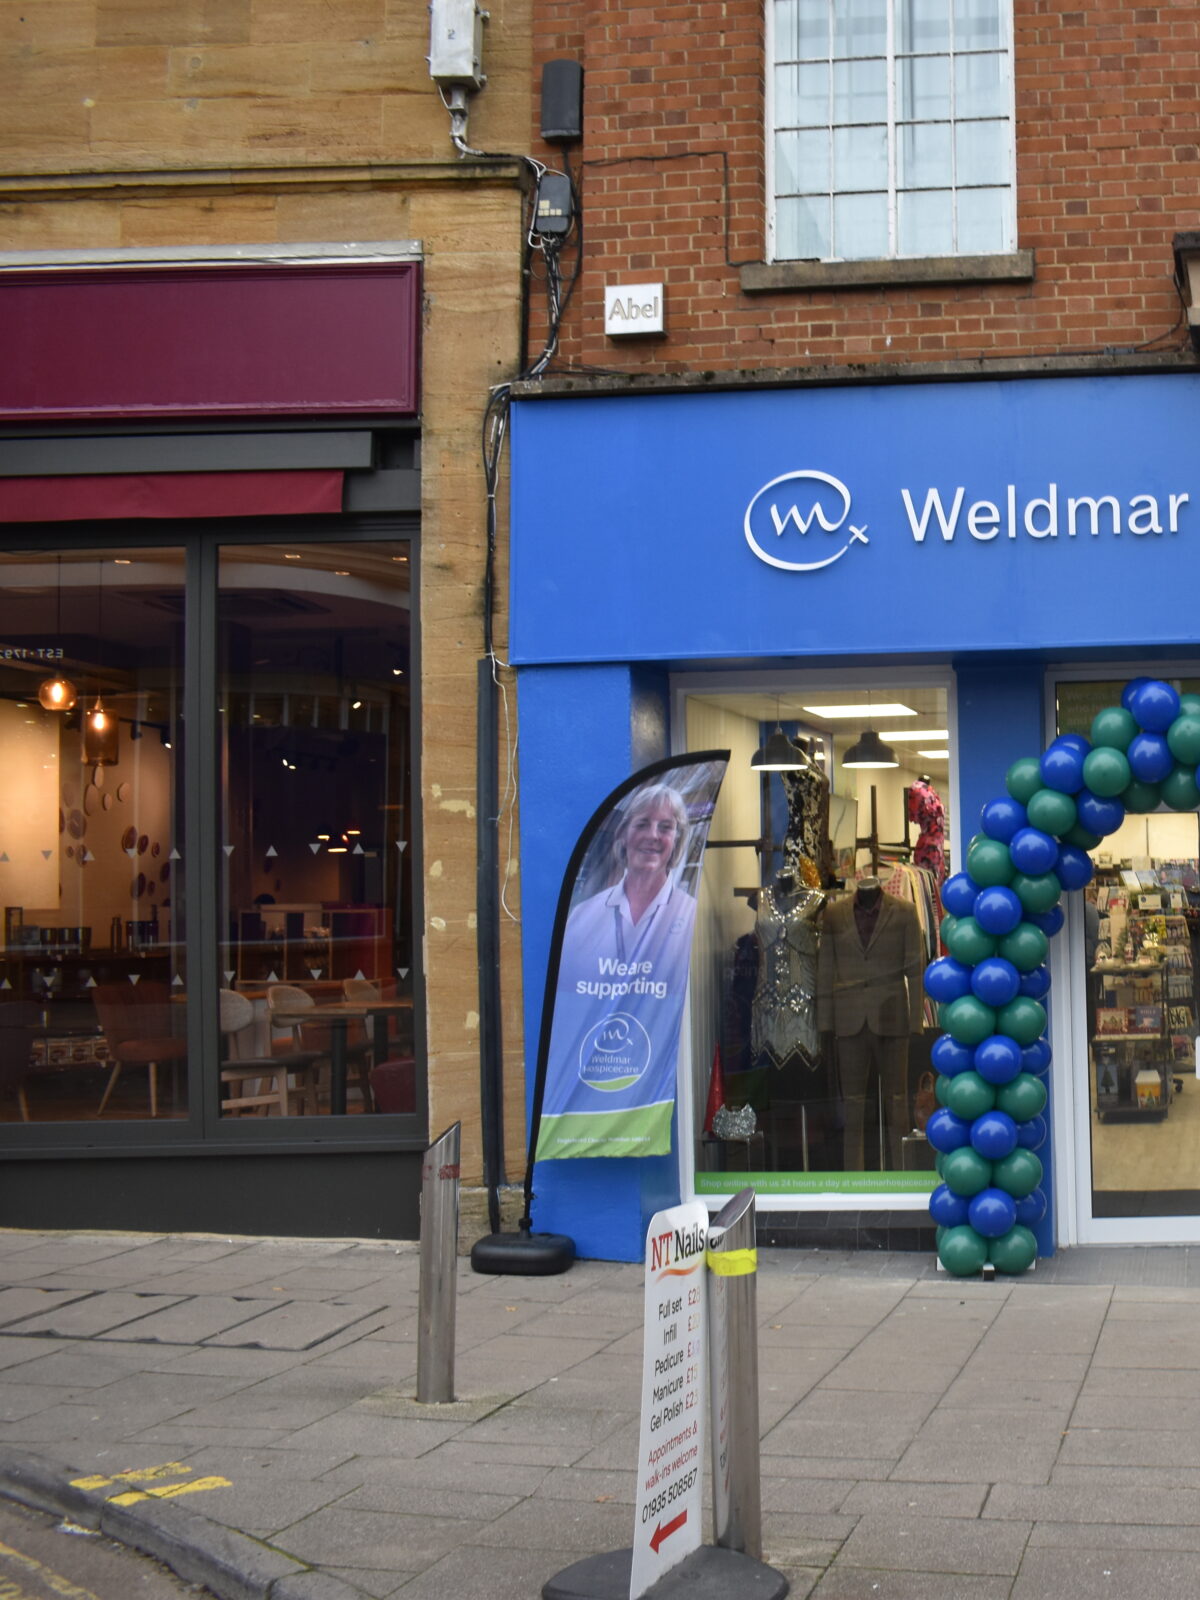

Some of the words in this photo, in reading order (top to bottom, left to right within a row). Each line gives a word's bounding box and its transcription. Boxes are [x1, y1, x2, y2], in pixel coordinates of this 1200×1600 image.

[608, 296, 659, 320] Abel
[900, 483, 1189, 542] Weldmar
[598, 957, 628, 977] We
[628, 960, 653, 975] are
[576, 977, 668, 1000] supporting
[750, 1178, 767, 1187] with
[792, 1178, 816, 1187] hours
[825, 1178, 839, 1189] day
[651, 1231, 672, 1272] NT
[674, 1222, 705, 1262] Nails
[658, 1299, 670, 1320] Full
[671, 1296, 682, 1315] set
[663, 1322, 677, 1346] Infill
[654, 1349, 684, 1377] Pedicure
[652, 1375, 684, 1406] Manicure
[650, 1409, 663, 1432] Gel
[663, 1398, 684, 1425] Polish
[648, 1426, 692, 1467] Appointments
[692, 1420, 698, 1436] &
[645, 1463, 671, 1492] walk-ins
[671, 1444, 698, 1473] welcome
[642, 1489, 667, 1524] 01935
[667, 1467, 698, 1505] 508567
